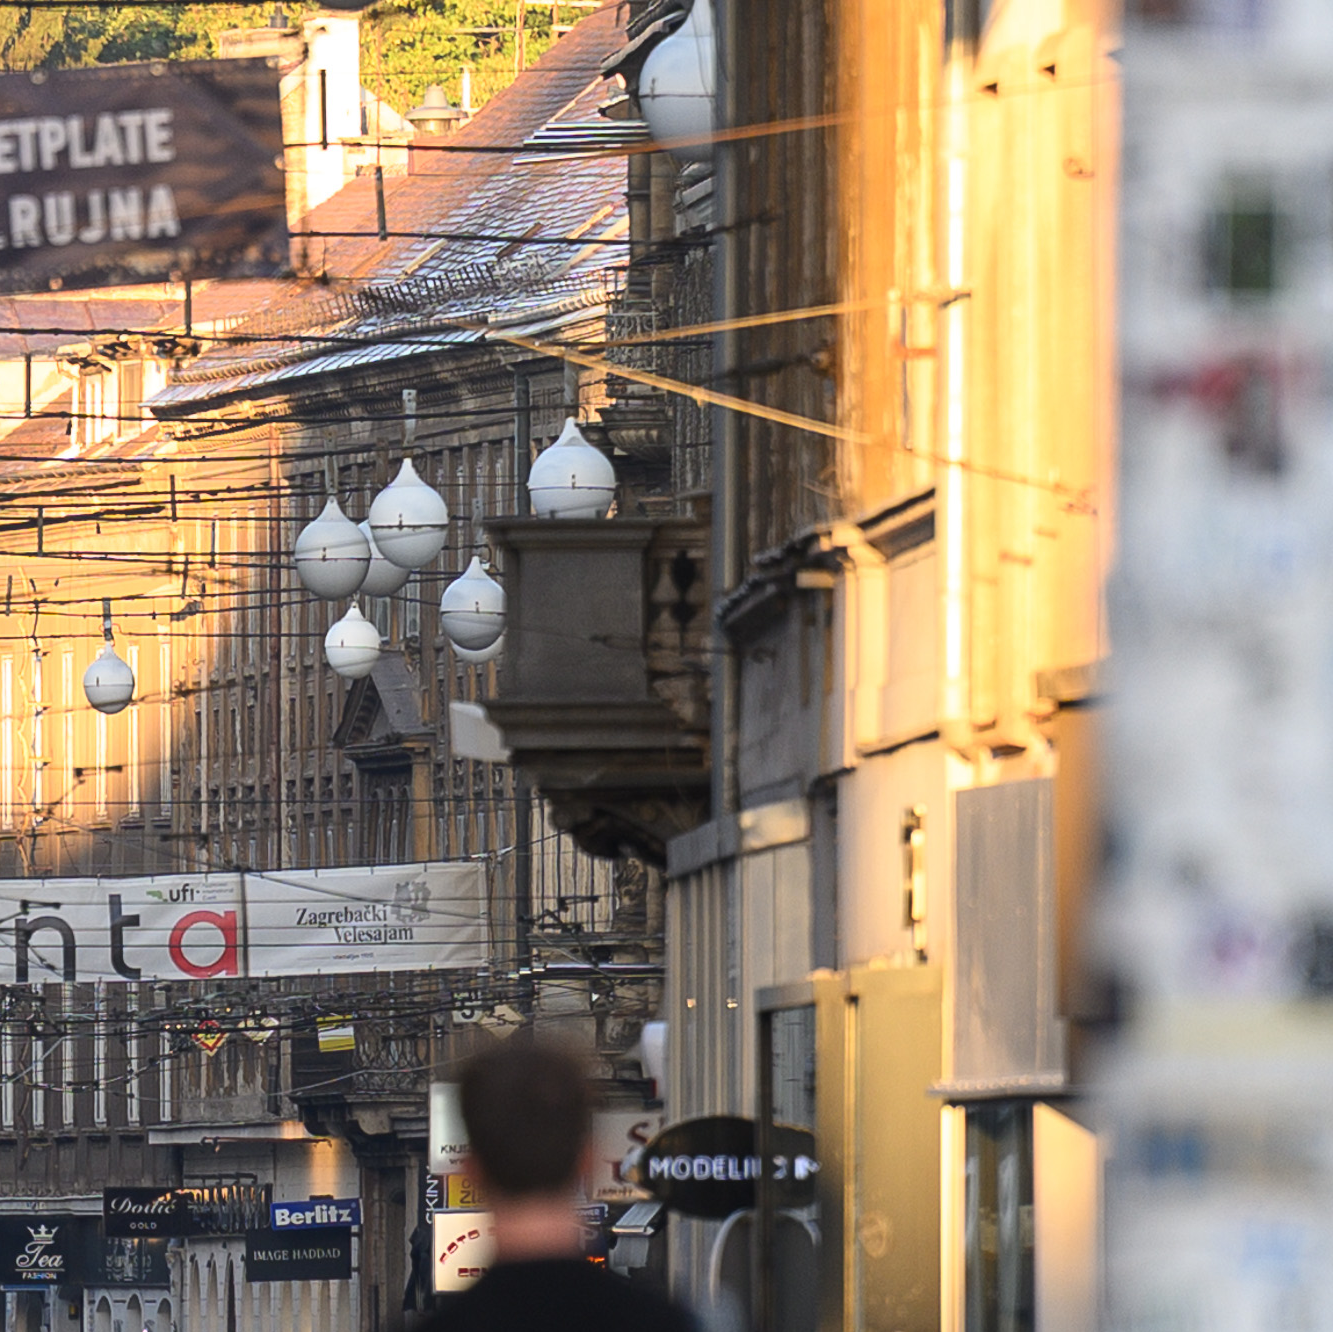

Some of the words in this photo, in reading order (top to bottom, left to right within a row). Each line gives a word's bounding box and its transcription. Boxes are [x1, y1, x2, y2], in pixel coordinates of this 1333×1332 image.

[296, 904, 389, 928] Zagrebački
[333, 925, 414, 943] Velesajam
[275, 1204, 352, 1226] Berlitz
[130, 1222, 157, 1230] GOLD
[16, 1241, 64, 1268] Tea
[253, 1249, 289, 1261] IMAGE
[292, 1248, 341, 1260] HADDAD
[22, 1271, 57, 1280] FASHION
